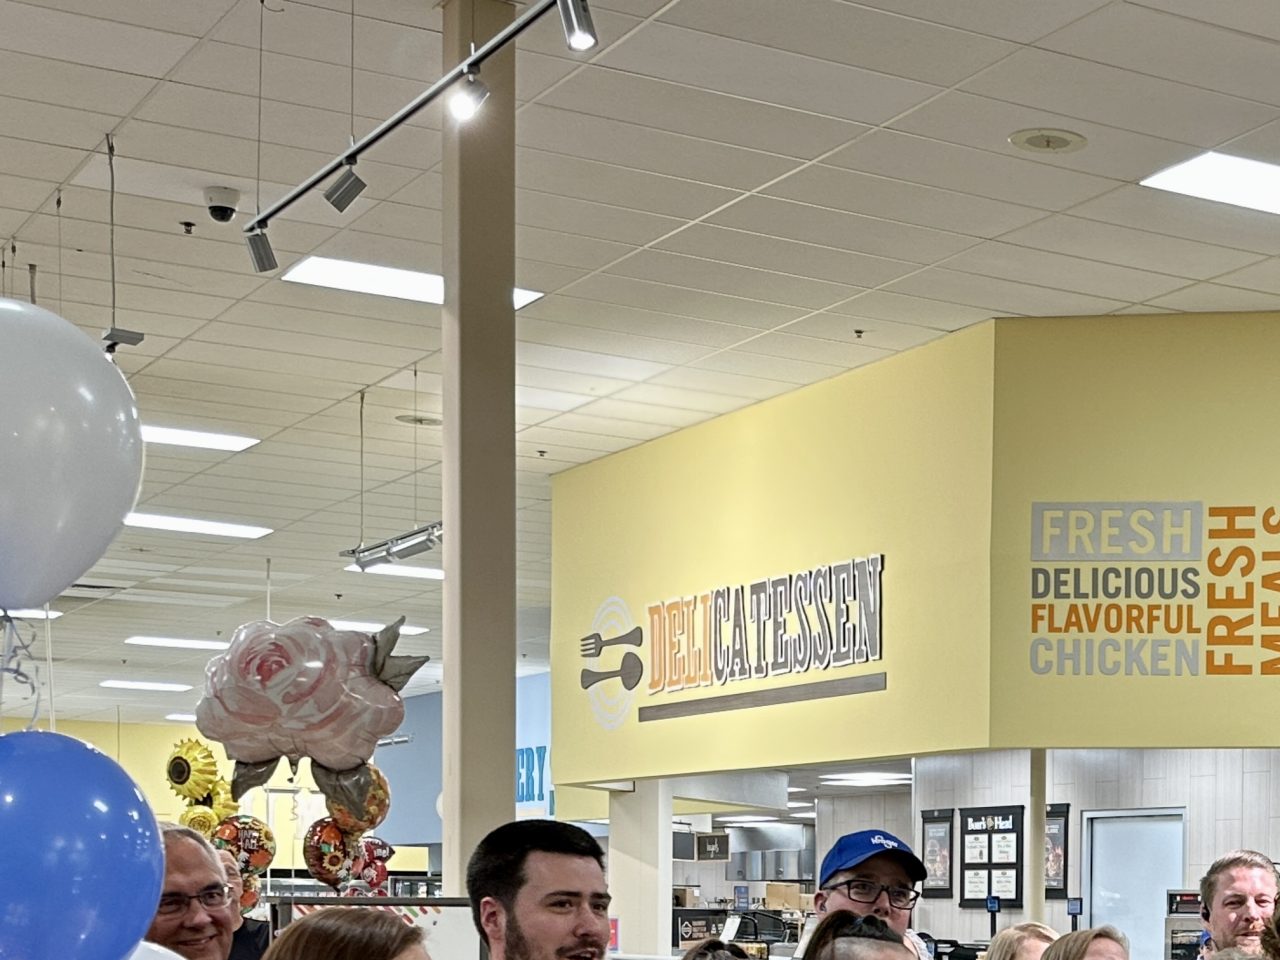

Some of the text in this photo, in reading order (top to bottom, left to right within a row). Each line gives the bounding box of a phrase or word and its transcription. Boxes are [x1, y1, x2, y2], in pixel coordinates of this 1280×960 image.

[1041, 509, 1192, 554] FRESH
[1031, 567, 1201, 600] DELICIOUS
[1205, 505, 1256, 676] FRESH
[647, 553, 886, 696] DELICATESSEN
[1031, 603, 1202, 634] FLAVORFUL
[1029, 637, 1200, 676] CHICKEN
[515, 746, 547, 803] ERY
